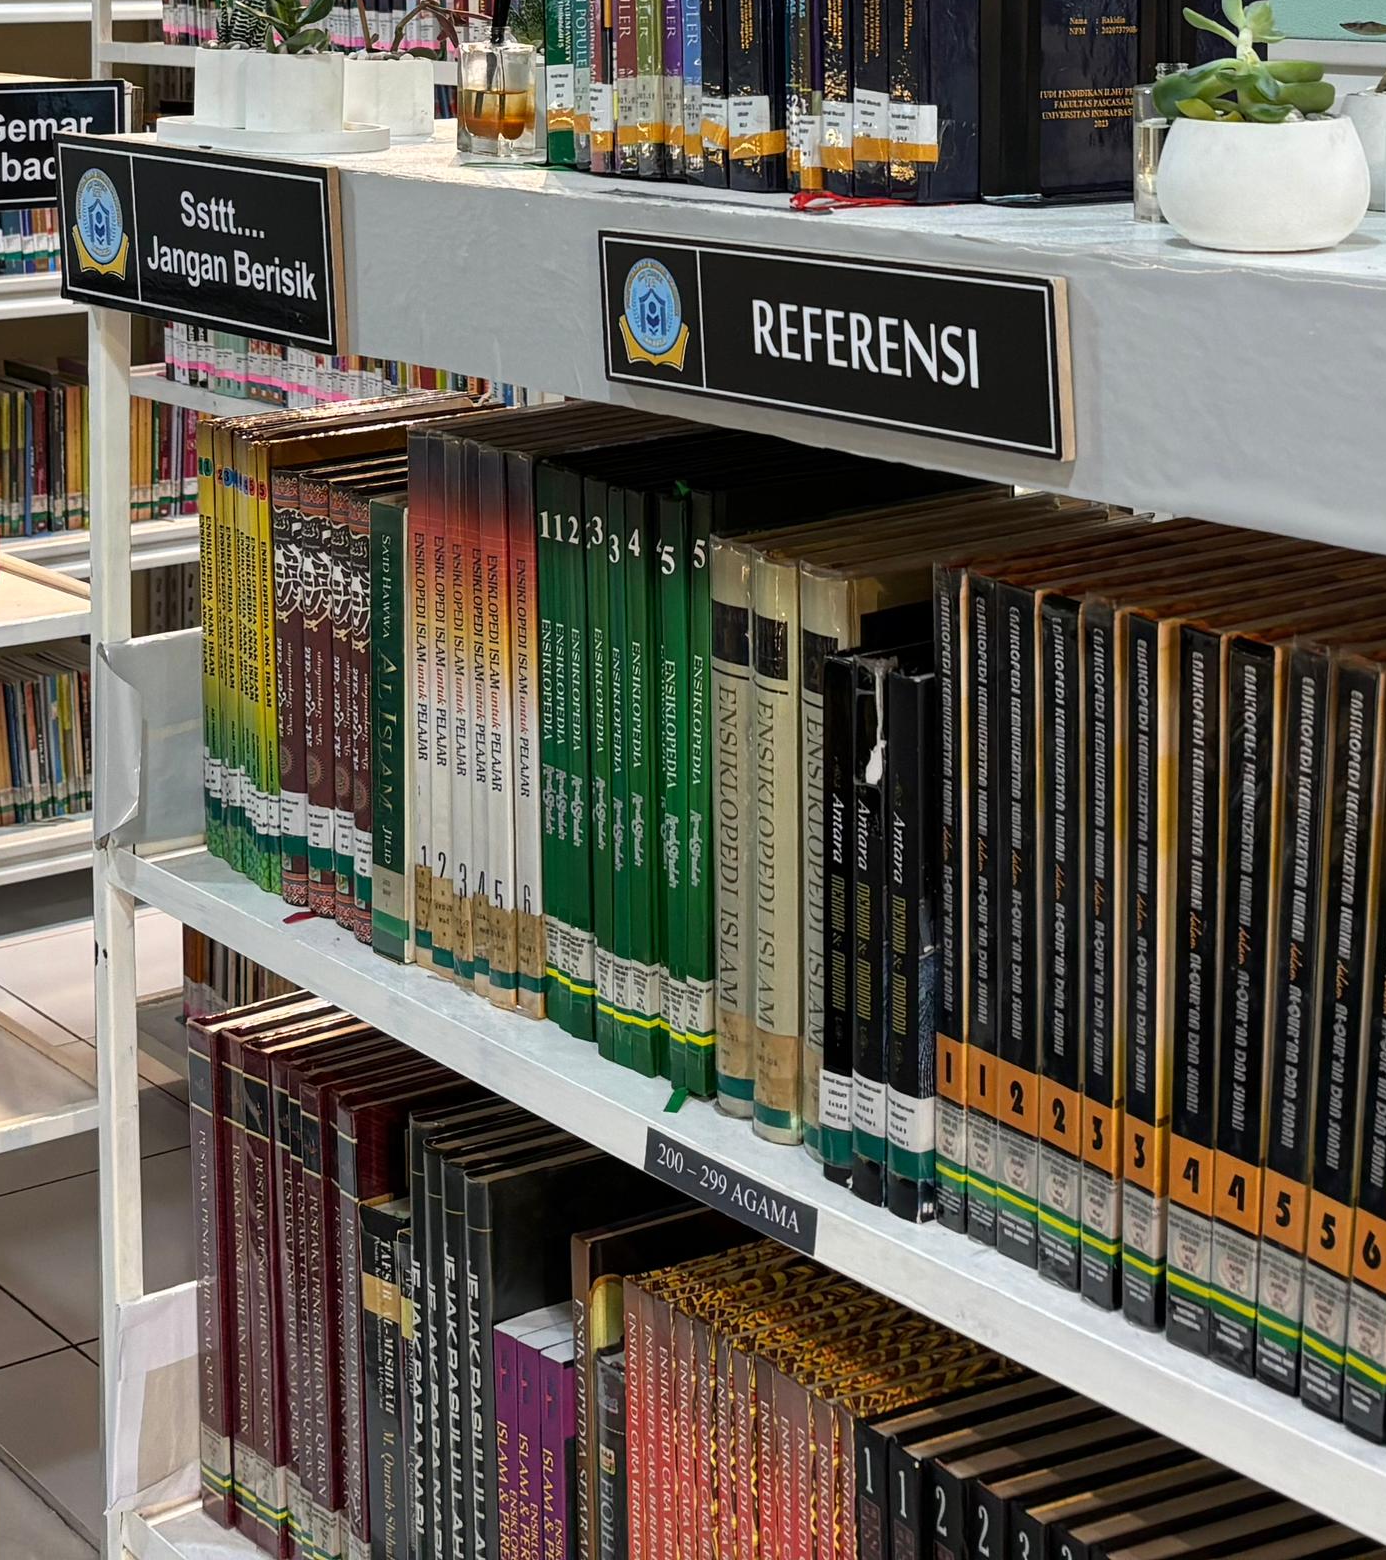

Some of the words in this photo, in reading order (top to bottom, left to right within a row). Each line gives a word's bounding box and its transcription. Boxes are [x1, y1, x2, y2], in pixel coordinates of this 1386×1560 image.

[575, 8, 587, 68] POPULE
[180, 190, 266, 239] Ssttt....
[147, 235, 228, 288] Jangan
[233, 249, 318, 301] Berisik
[751, 298, 980, 389] REFERENSI
[553, 513, 564, 542] 1
[608, 534, 620, 564] 3
[628, 528, 641, 557] 4
[692, 539, 706, 569] 5
[260, 541, 270, 629] ENSIKLOPEDIA
[381, 577, 392, 639] HAWWA
[453, 543, 464, 632] ENSIKLOPEDI
[487, 555, 499, 645] ENSIKLOPEDI
[516, 559, 527, 649] ENSIKLOPEDI
[263, 632, 272, 666] ANAK
[376, 646, 398, 701] AL
[454, 634, 465, 677] ISLAM
[489, 647, 500, 690] ISLAM
[517, 652, 528, 696] ISLAM
[265, 668, 273, 709] ISLAM
[455, 677, 463, 716] untuk
[491, 690, 500, 730] untuk
[519, 696, 528, 735] untuk
[611, 646, 621, 774] ENSIKLOPEDIA
[631, 641, 642, 769] ENSIKLOPEDIA
[456, 717, 467, 777] PELAJAR
[664, 659, 676, 789] ENSIKLOPEDIA
[691, 654, 703, 785] ENSIKLOPEDIA
[376, 708, 398, 816] ISLAM
[491, 731, 503, 793] PELAJAR
[520, 736, 530, 799] PELAJAR
[718, 684, 739, 905] ENSIKLOPEDI
[756, 698, 775, 921] ENSIKLOPEDI
[805, 714, 824, 937] ENSIKLOPEDI
[832, 793, 845, 865] Antara
[857, 798, 870, 871] Antara
[893, 811, 906, 885] Antara
[719, 909, 739, 1008] ISLAM
[756, 926, 775, 1029] ISLAM
[805, 943, 824, 1048] ISLAM
[945, 1051, 952, 1083] 1
[979, 1063, 986, 1097] 1
[1010, 1080, 1024, 1116] 2
[1052, 1098, 1066, 1134] 2
[1092, 1115, 1104, 1151] 3
[1133, 1133, 1146, 1169] 3
[656, 1142, 684, 1174] 200
[699, 1164, 728, 1196] 299
[730, 1182, 800, 1234] AGAMA
[1182, 1157, 1200, 1194] 4
[1227, 1174, 1246, 1212] 4
[1275, 1191, 1292, 1228] 5
[1320, 1212, 1336, 1250] 5
[1363, 1230, 1382, 1269] 6
[443, 1242, 458, 1347] JEJAK
[627, 1311, 640, 1425] ENSIKLOPEDI
[446, 1347, 464, 1560] RASULULLAH
[496, 1419, 511, 1483] ISLAM
[518, 1432, 531, 1497] ISLAM
[542, 1446, 555, 1511] ISLAM
[630, 1428, 640, 1475] CARA
[935, 1485, 948, 1537] 2
[978, 1505, 990, 1558] 2
